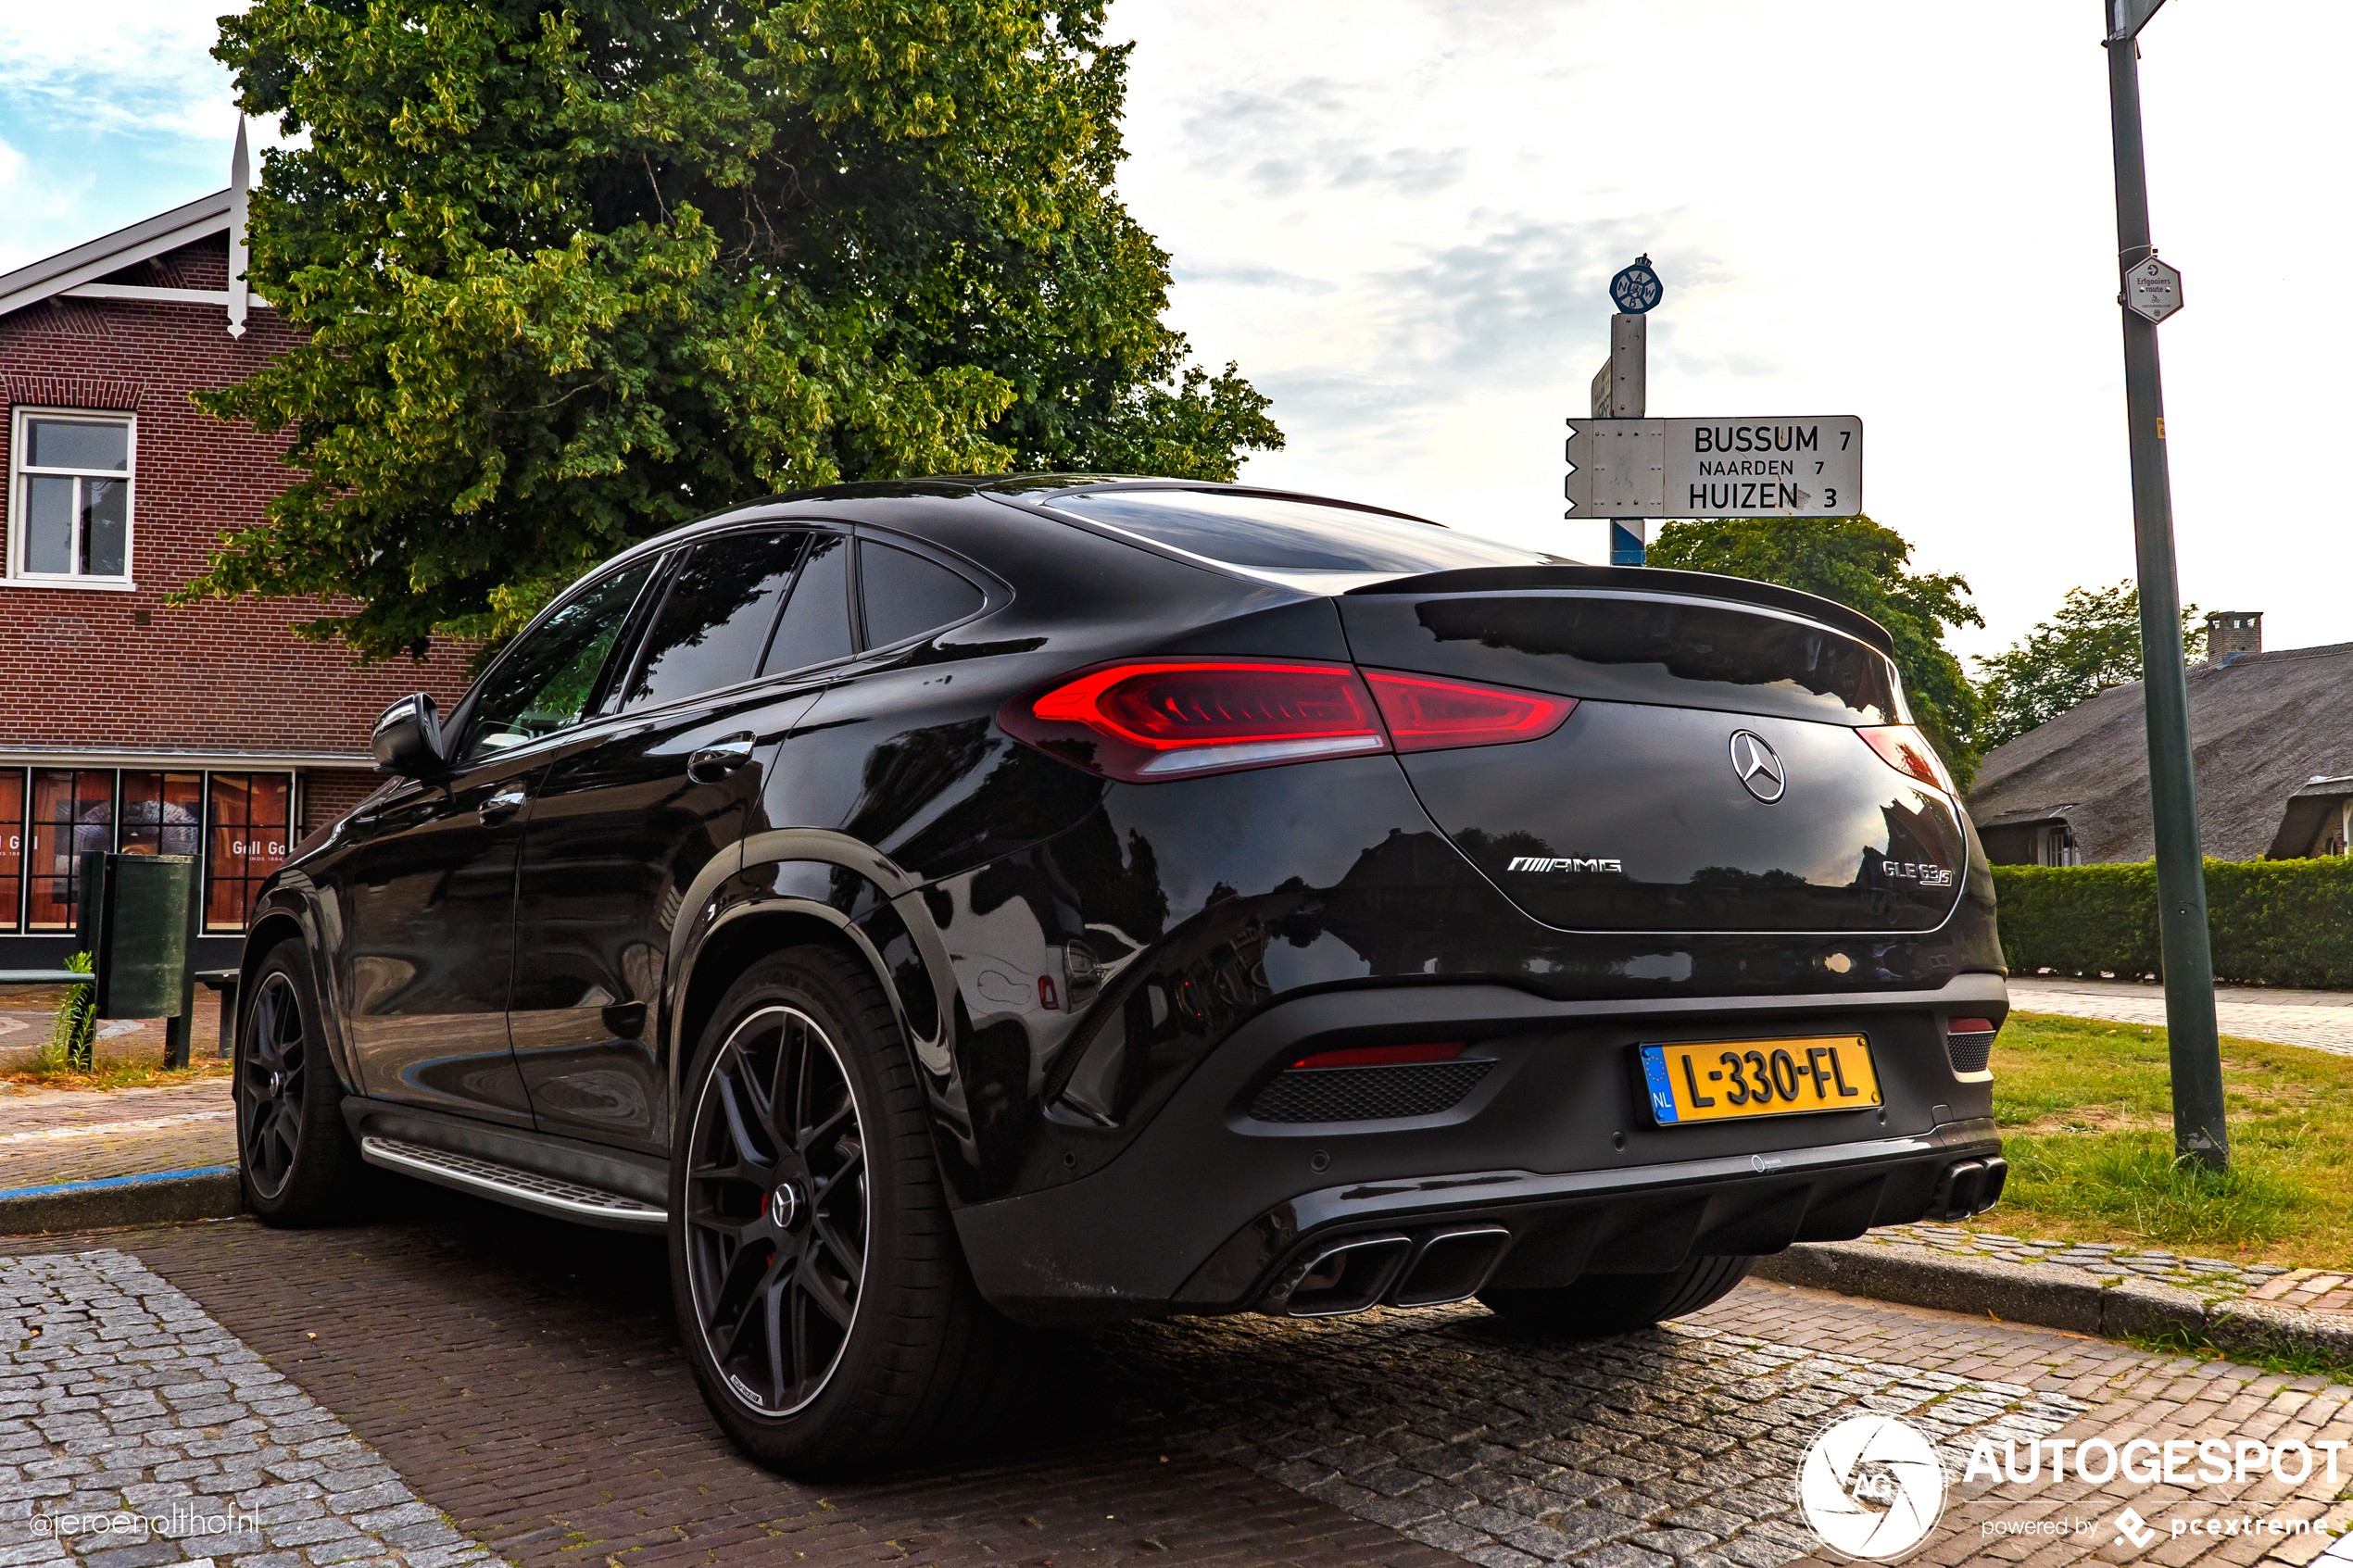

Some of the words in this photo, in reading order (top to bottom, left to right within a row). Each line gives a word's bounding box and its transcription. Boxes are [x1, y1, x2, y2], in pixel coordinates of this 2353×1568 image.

[2137, 278, 2171, 286] Erfgooiers
[1694, 425, 1818, 453] BUSSUM
[1839, 431, 1851, 451] 7
[1699, 459, 1793, 476] NAARDEN
[1815, 461, 1825, 475] 7
[1689, 483, 1798, 509] HUIZEN
[1823, 487, 1837, 508] 3
[1681, 1047, 1858, 1108] L-330-FL
[1652, 1092, 1672, 1108] NL
